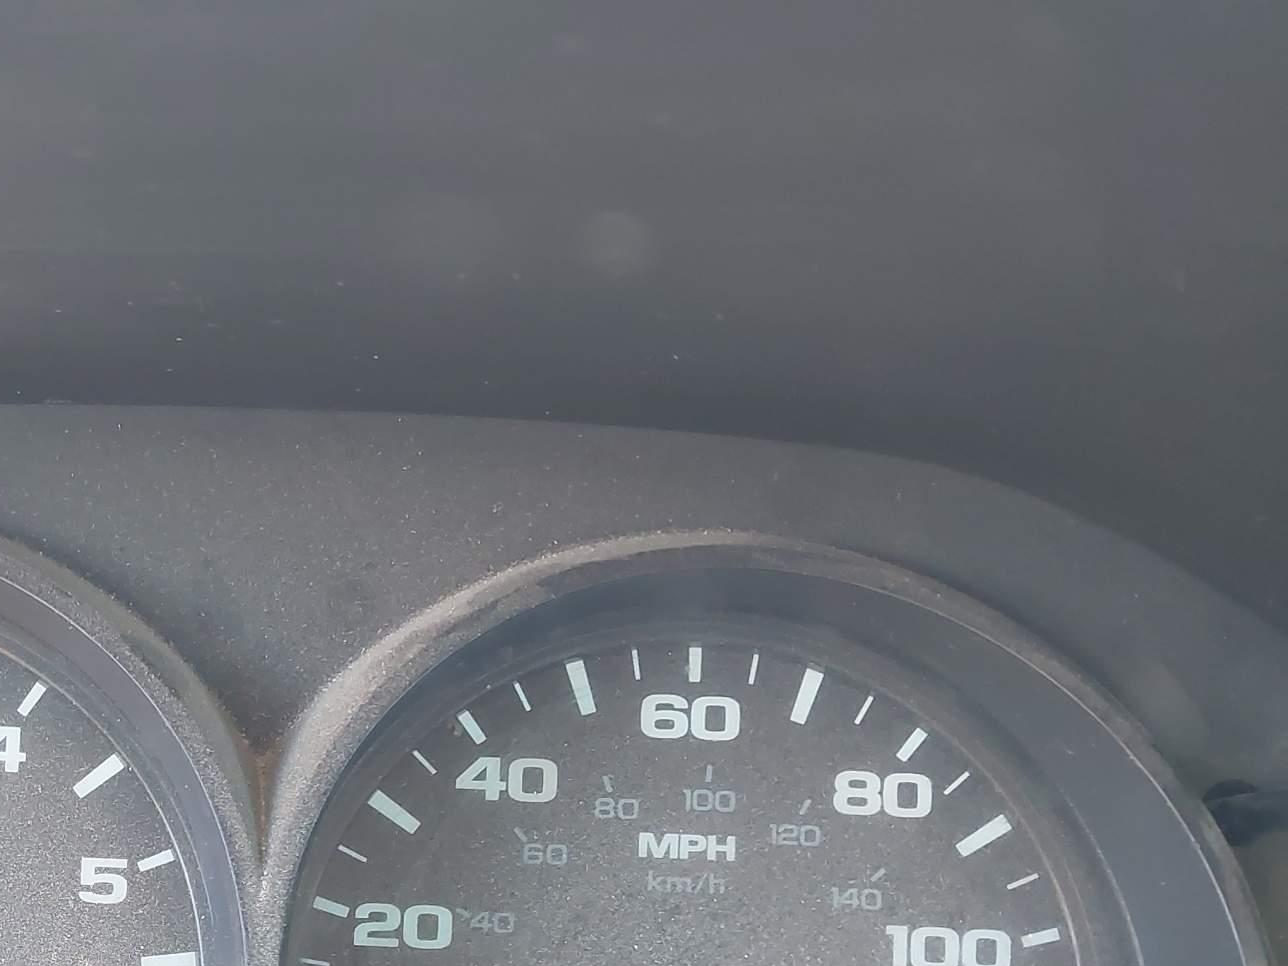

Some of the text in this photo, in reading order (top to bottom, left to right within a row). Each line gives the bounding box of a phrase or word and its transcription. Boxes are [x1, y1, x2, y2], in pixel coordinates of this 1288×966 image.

[640, 694, 741, 742] 60
[455, 757, 558, 804] 40
[684, 790, 736, 813] 100
[833, 770, 933, 818] 80
[593, 798, 640, 821] 80
[638, 833, 736, 861] MPH
[769, 824, 822, 847] 120
[522, 843, 568, 867] 60
[79, 857, 129, 904] 5
[647, 872, 726, 895] km/h
[830, 887, 883, 911] 140
[353, 903, 453, 950] 20
[470, 911, 514, 934] 40
